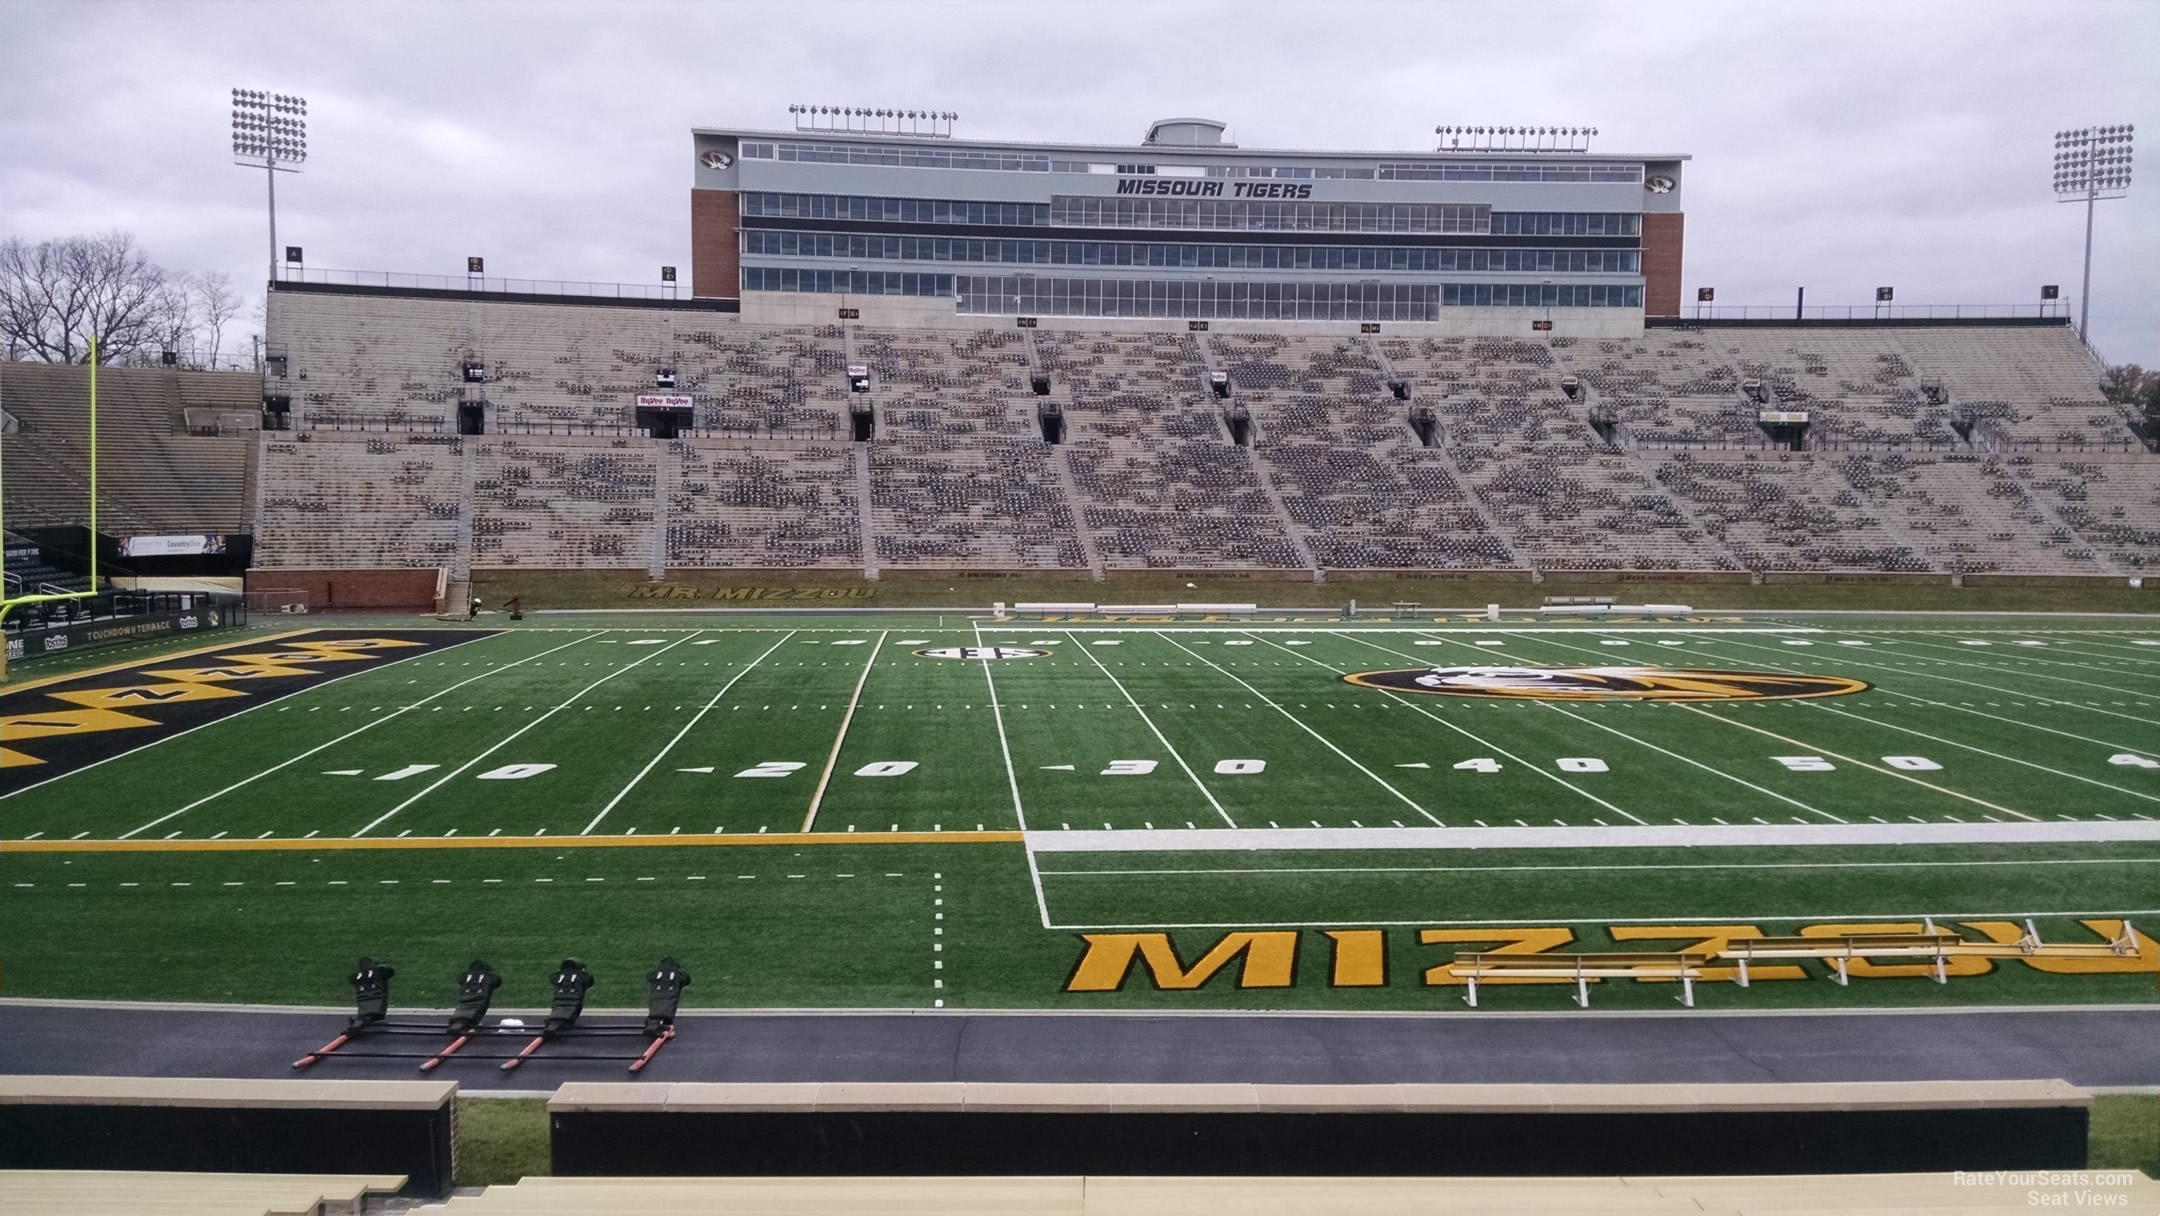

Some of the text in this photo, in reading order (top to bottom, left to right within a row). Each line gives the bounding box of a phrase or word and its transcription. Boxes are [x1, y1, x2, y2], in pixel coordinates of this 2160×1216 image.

[1116, 178, 1313, 199] MISSOURI TIGERS
[713, 586, 879, 601] MIZZOU
[87, 620, 171, 641] TOUCHDOWN TERRACE
